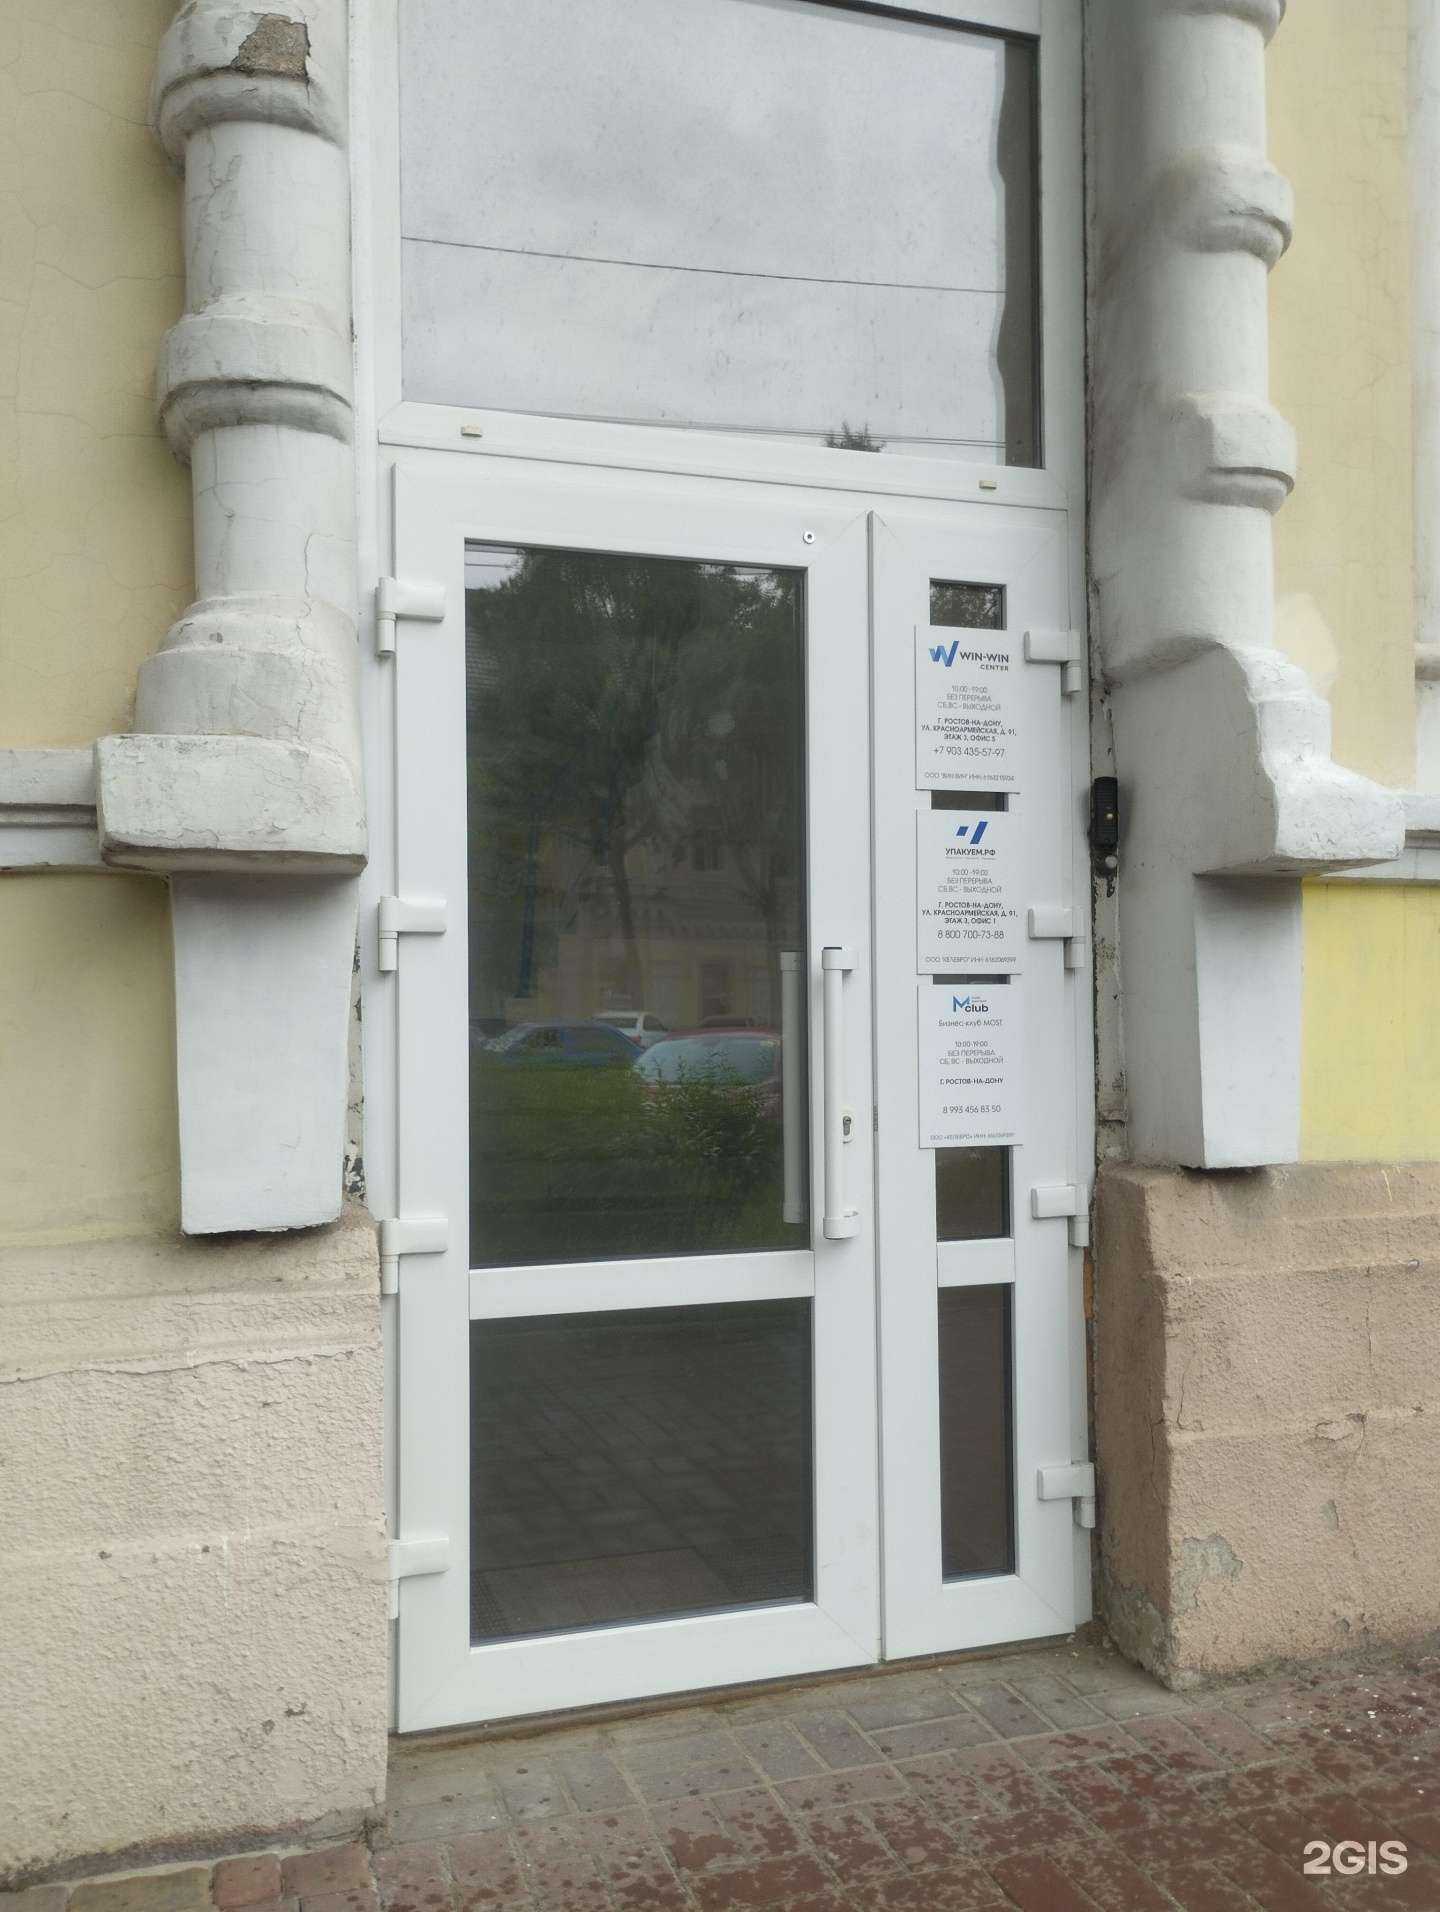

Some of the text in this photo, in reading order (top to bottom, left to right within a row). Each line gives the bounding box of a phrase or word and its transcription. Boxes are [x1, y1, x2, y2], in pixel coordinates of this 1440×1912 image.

[960, 651, 1009, 663] WIN-WIN
[963, 703, 1002, 711] ВЫХОДНОЙ
[933, 725, 999, 735] КРАСНОАРМЕЙСКАЯ,
[932, 746, 1005, 757] +7 903 435-57-97
[945, 848, 996, 856] УПАКУЕМ.РФ
[933, 909, 999, 917] КРАСНОАРМЕЙСКАЯ,
[945, 930, 960, 939] 800
[963, 930, 1004, 939] 700-73-88
[938, 1019, 981, 1027] Бизнес-клуб
[965, 1105, 978, 1113] 456
[980, 1105, 989, 1113] 83
